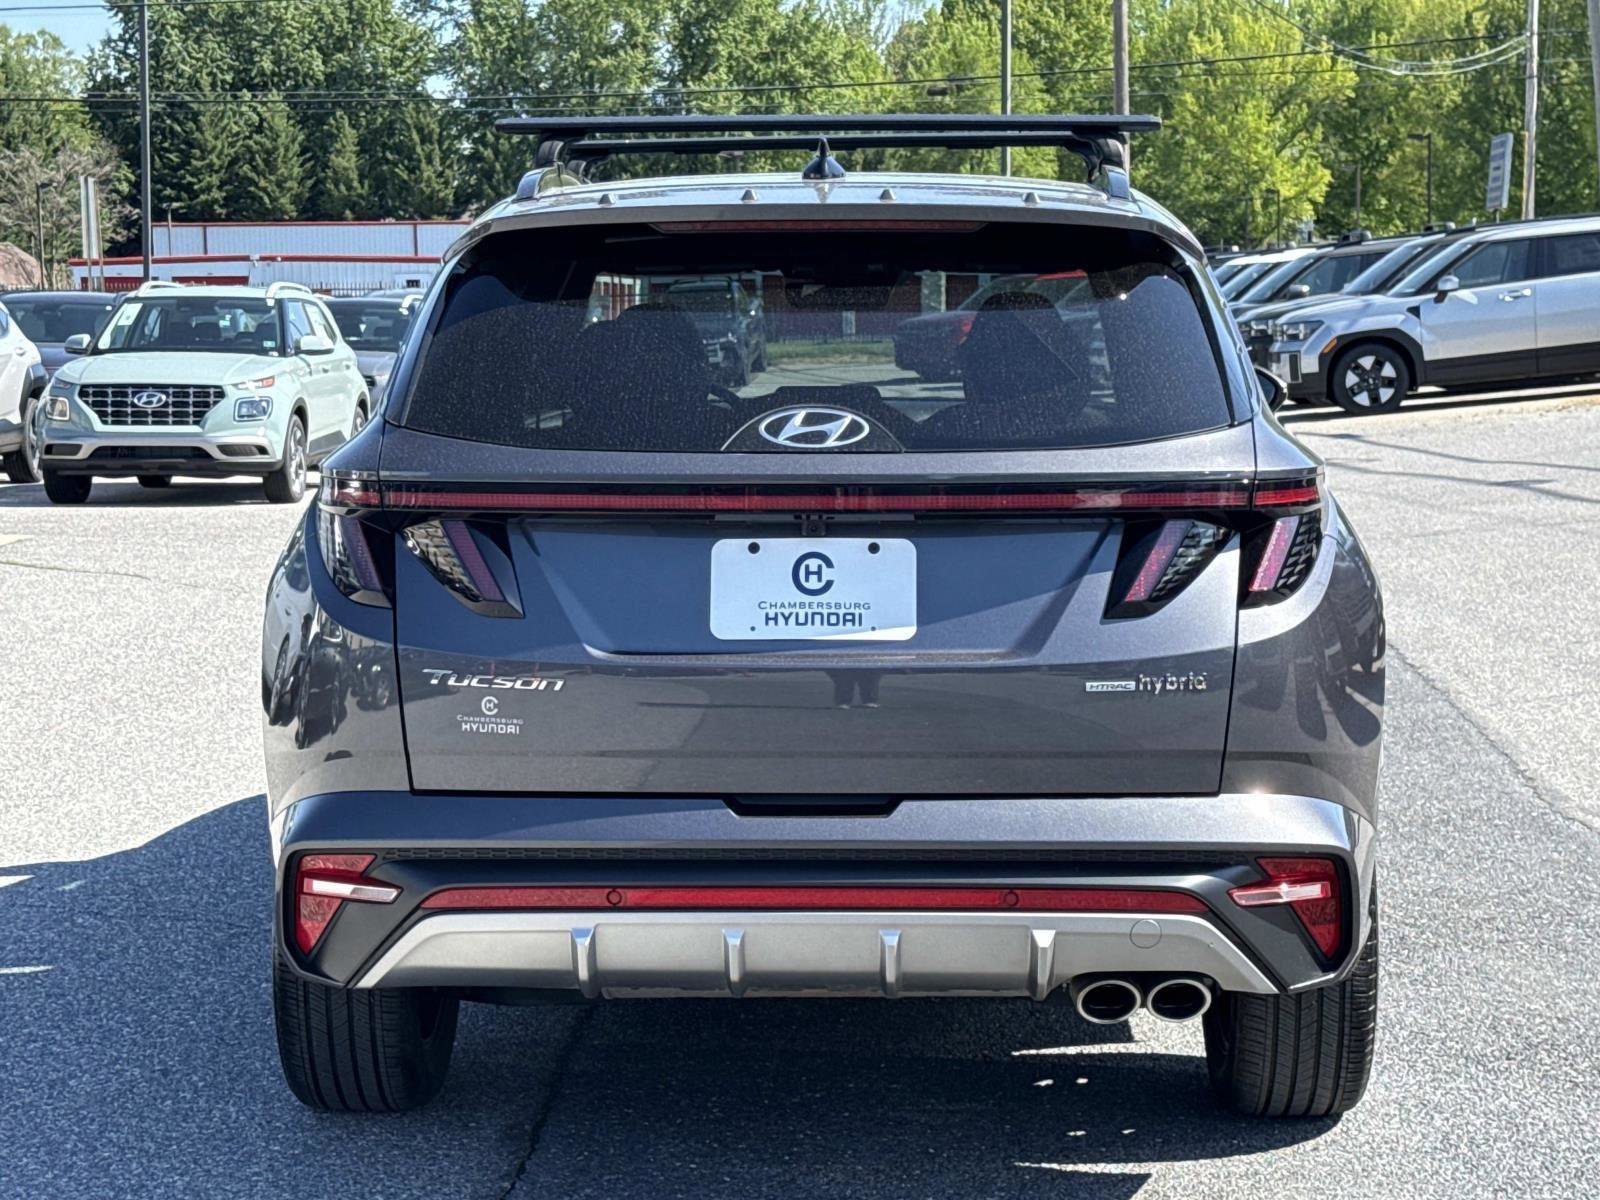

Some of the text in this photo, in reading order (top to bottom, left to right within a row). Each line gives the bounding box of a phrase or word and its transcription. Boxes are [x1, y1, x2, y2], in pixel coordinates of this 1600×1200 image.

[758, 600, 871, 611] CHAMBERSBURG
[765, 612, 862, 627] HYUNDAI
[1087, 671, 1208, 695] HTRAC hybrid
[456, 714, 524, 725] CHAMBERSBURG
[462, 723, 520, 735] HYUNDAI
